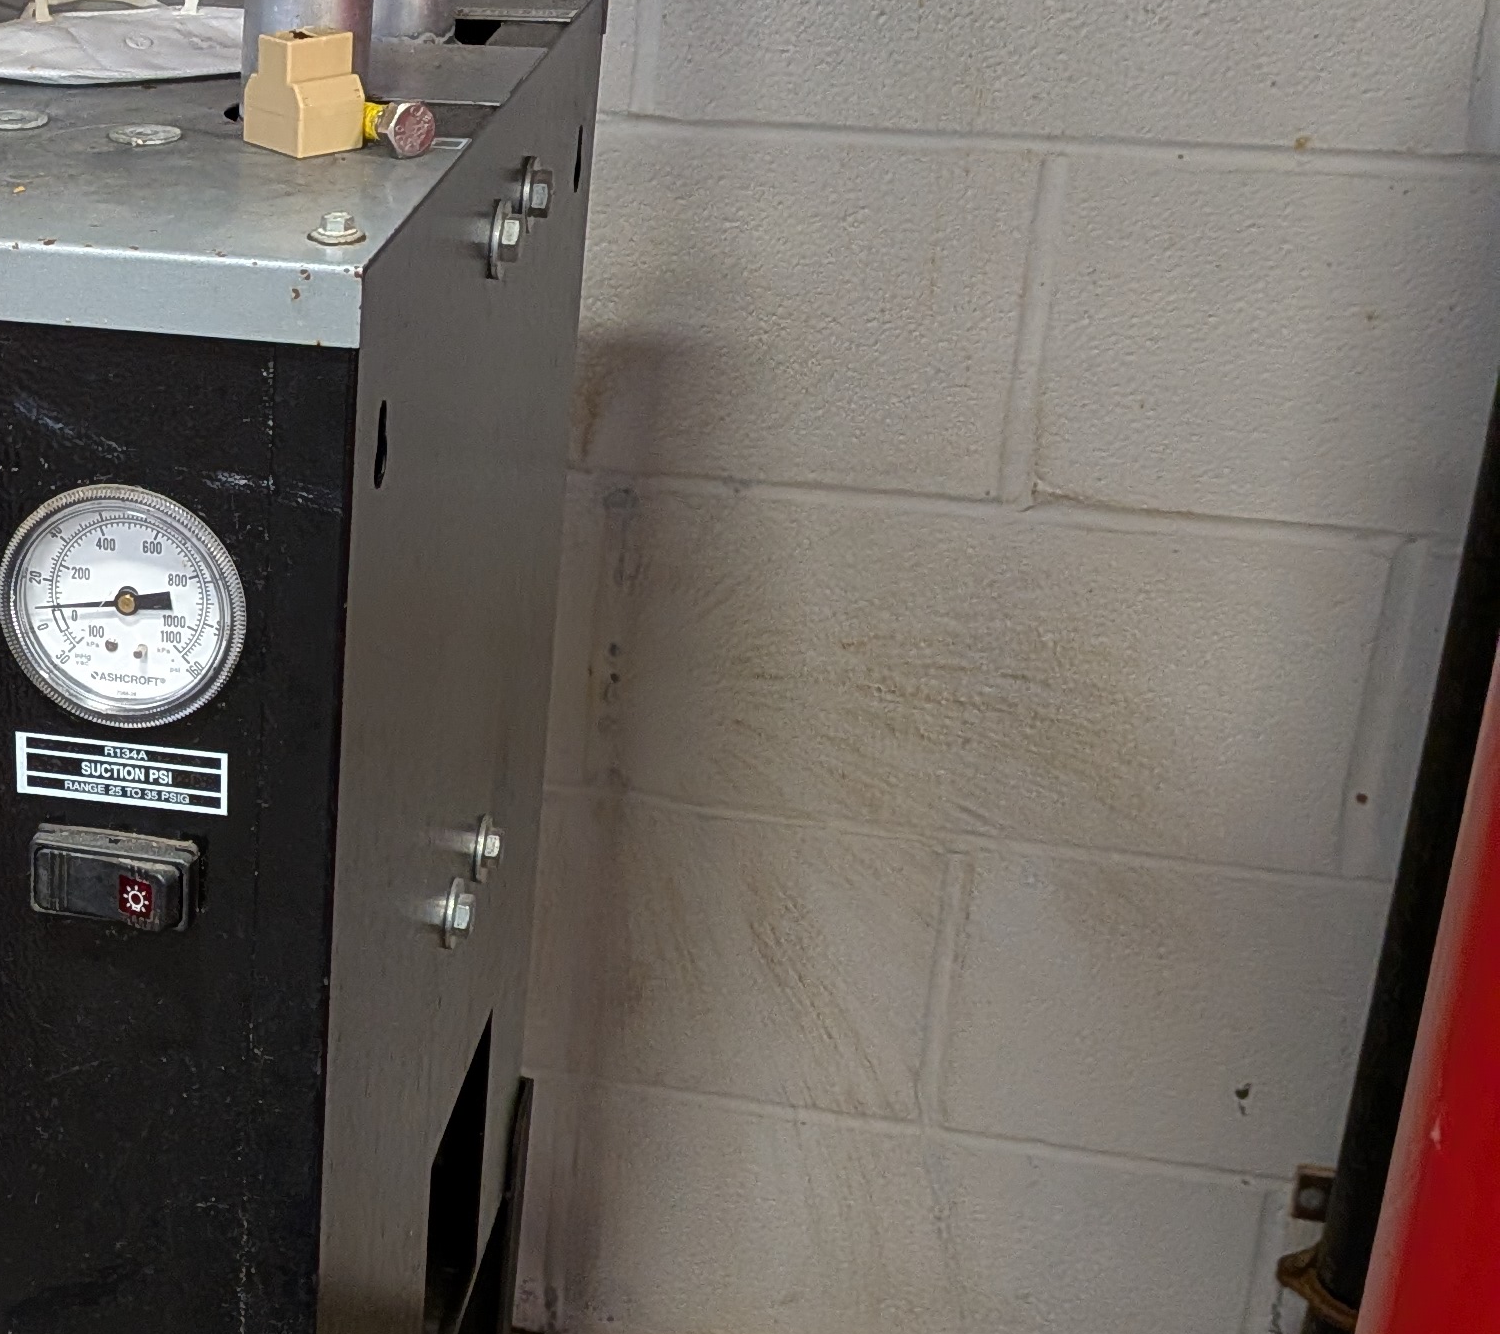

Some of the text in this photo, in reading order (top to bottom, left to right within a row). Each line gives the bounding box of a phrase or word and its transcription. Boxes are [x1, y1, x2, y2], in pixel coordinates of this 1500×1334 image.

[50, 525, 63, 539] 40
[96, 537, 116, 551] 400
[142, 541, 163, 555] 600
[29, 570, 42, 585] 20
[71, 567, 91, 581] 200
[168, 574, 188, 588] 800
[71, 611, 78, 621] 0
[163, 614, 186, 628] 1000
[160, 630, 181, 644] 1100
[56, 651, 70, 665] 30
[186, 661, 204, 679] 160
[100, 672, 160, 686] ASHCROFT
[104, 746, 148, 761] R134A
[81, 761, 173, 785] SUCTION PSI
[64, 780, 190, 804] RANGE 25 TO 35 PSIG
